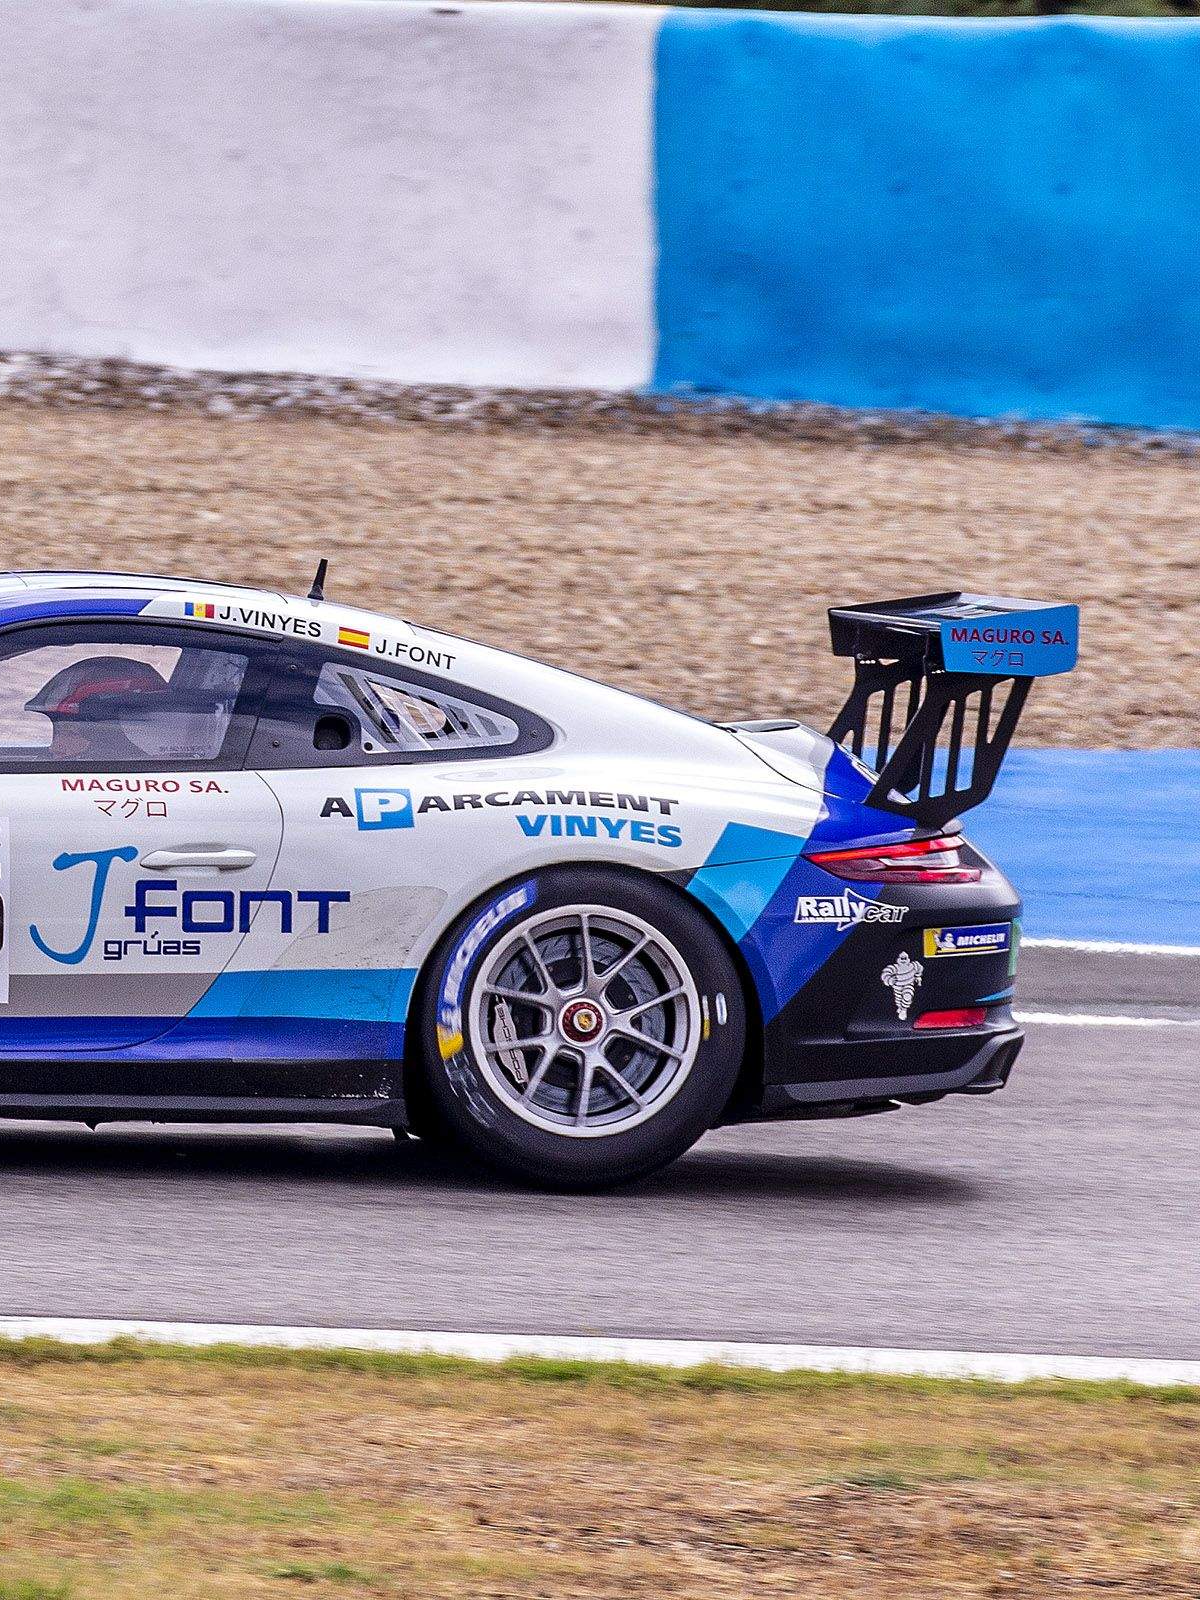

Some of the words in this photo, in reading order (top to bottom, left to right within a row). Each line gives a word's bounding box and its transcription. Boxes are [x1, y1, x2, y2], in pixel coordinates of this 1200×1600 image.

[219, 606, 322, 638] J.VINYES
[951, 628, 1035, 644] MAGURO
[1041, 630, 1069, 646] SA.
[375, 639, 457, 670] J.FONT
[971, 649, 1024, 667] マグロ
[61, 778, 180, 793] MAGURO
[190, 780, 229, 794] SA.
[93, 797, 168, 818] マグロ
[515, 814, 683, 848] VINYES
[799, 897, 909, 924] Rallycar
[103, 930, 201, 961] grúas
[956, 933, 1005, 947] MICHELIN
